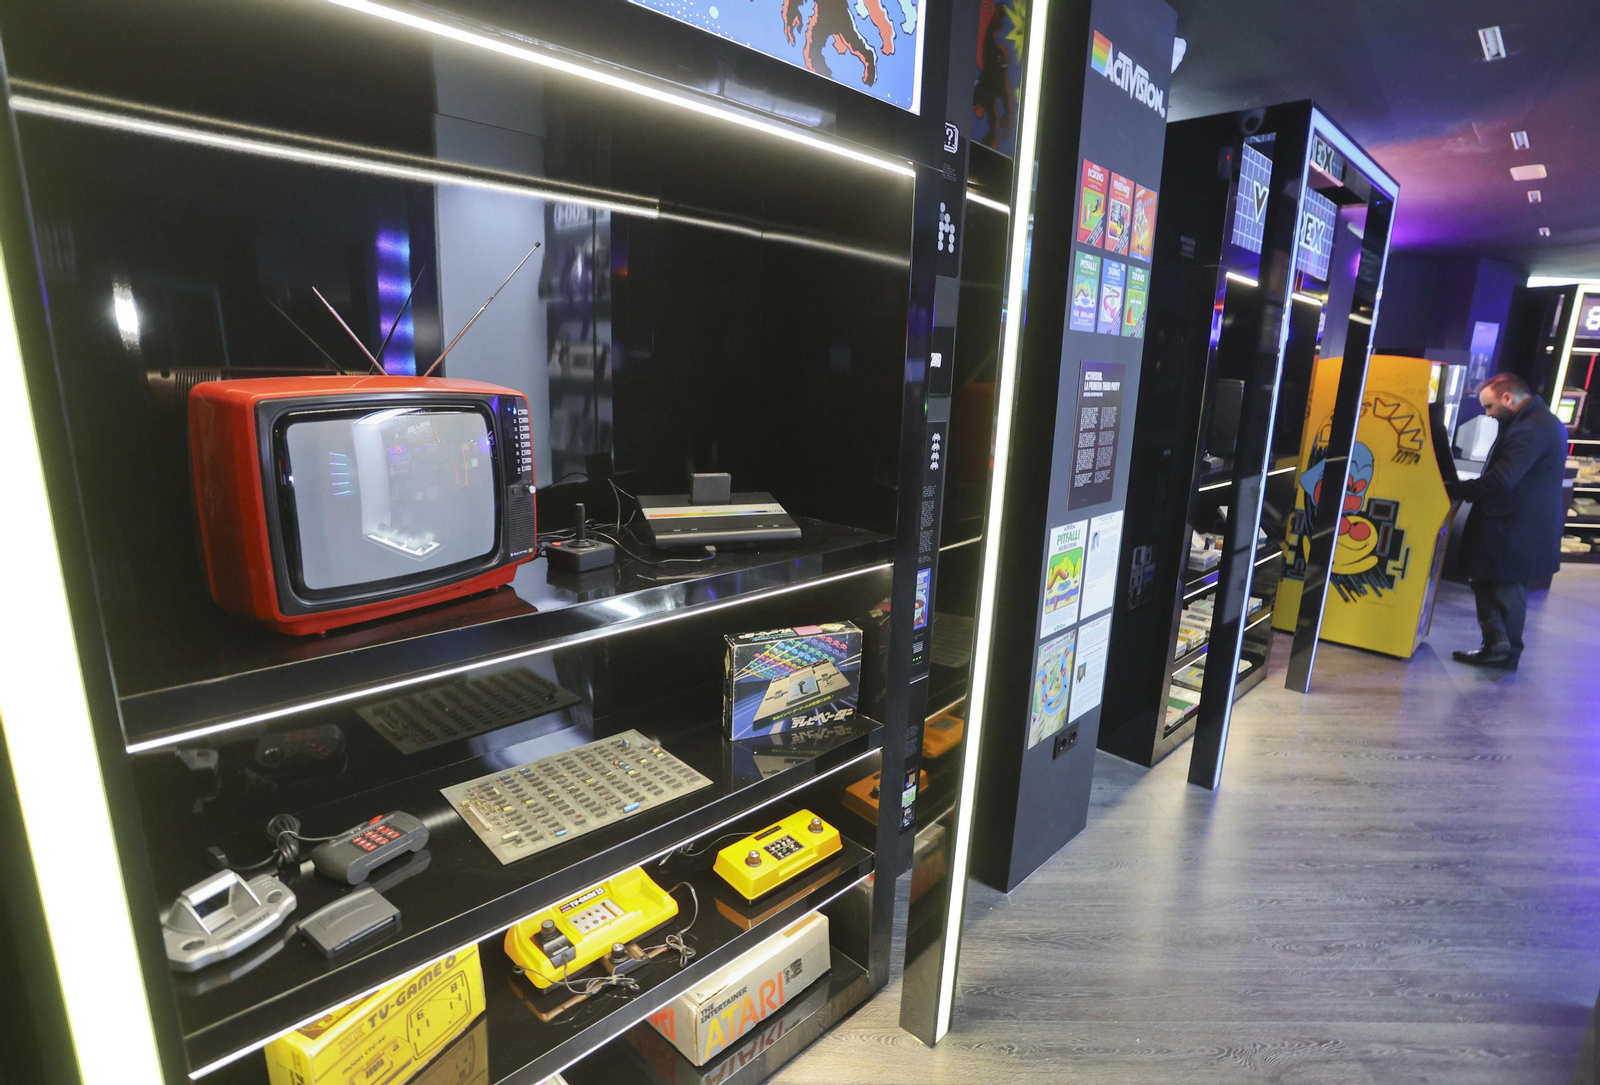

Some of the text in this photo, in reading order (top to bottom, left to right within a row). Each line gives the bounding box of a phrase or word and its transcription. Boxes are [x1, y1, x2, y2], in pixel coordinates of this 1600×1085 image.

[1103, 42, 1165, 118] ACTIVISION
[1056, 529, 1081, 546] PITFALL!
[367, 962, 442, 1028] TV-GAME
[444, 954, 457, 970] 6
[700, 986, 748, 1024] ENTERTAINER
[700, 1002, 715, 1017] THE
[704, 970, 785, 1061] ATARI
